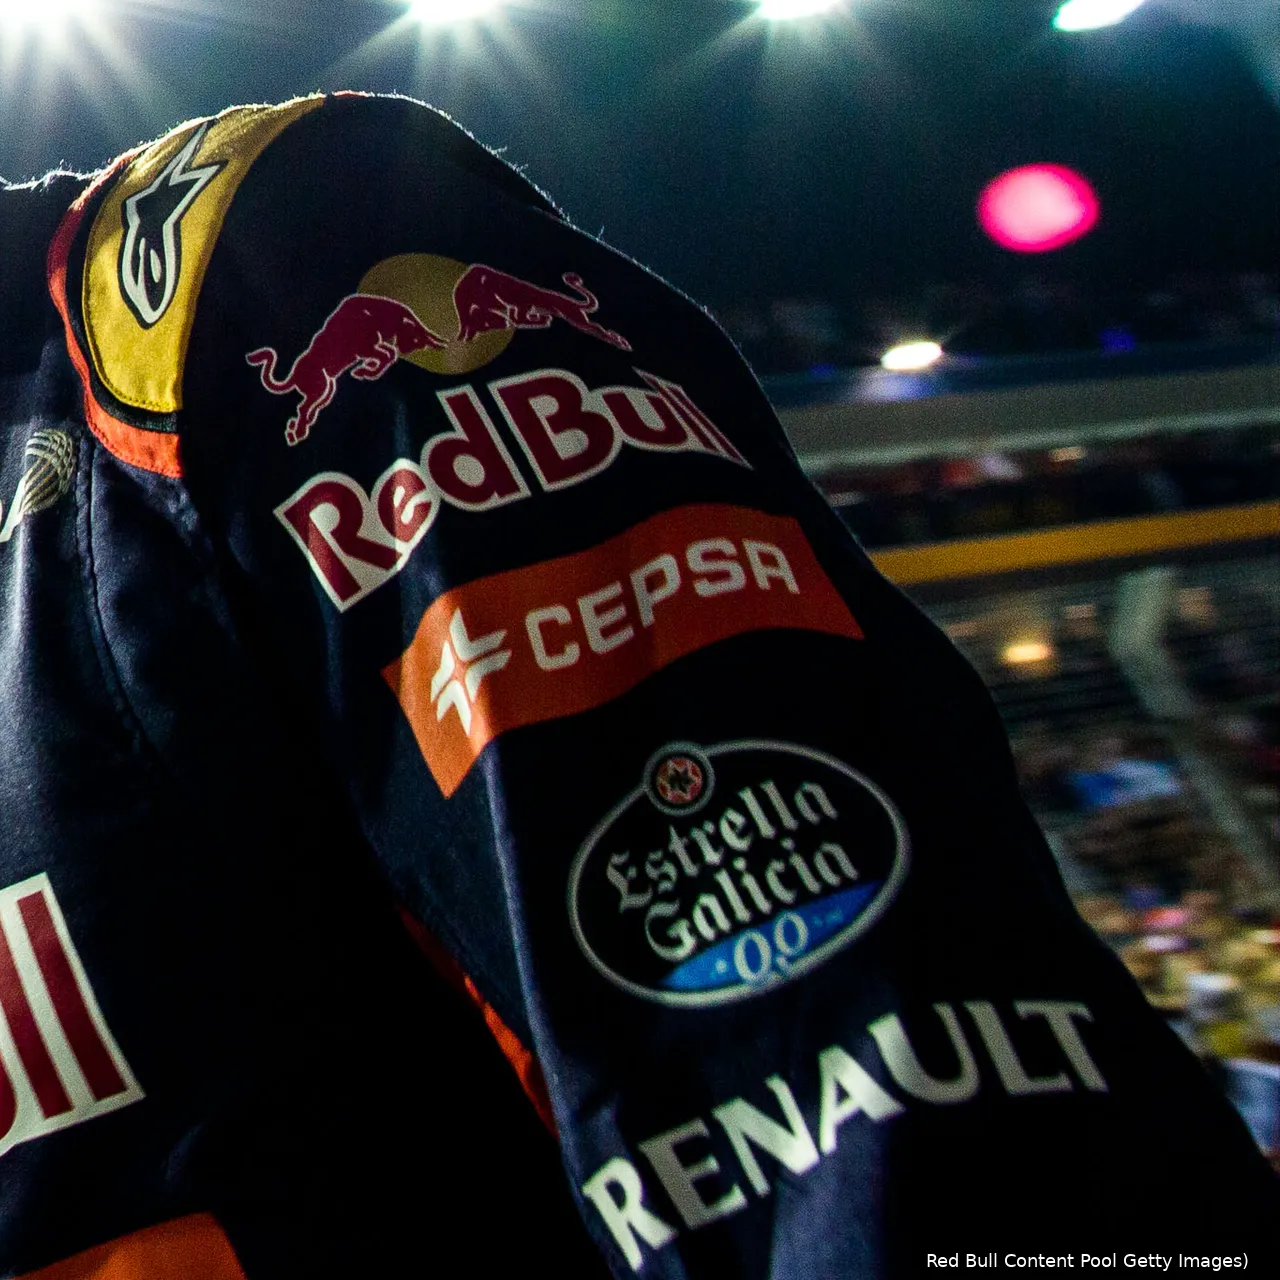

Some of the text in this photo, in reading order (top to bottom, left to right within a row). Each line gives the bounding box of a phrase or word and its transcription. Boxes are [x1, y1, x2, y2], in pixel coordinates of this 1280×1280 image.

[527, 540, 800, 672] CEPSA
[606, 779, 838, 913] Estrella
[645, 841, 858, 962] Galicia
[582, 999, 1109, 1271] RENAULT
